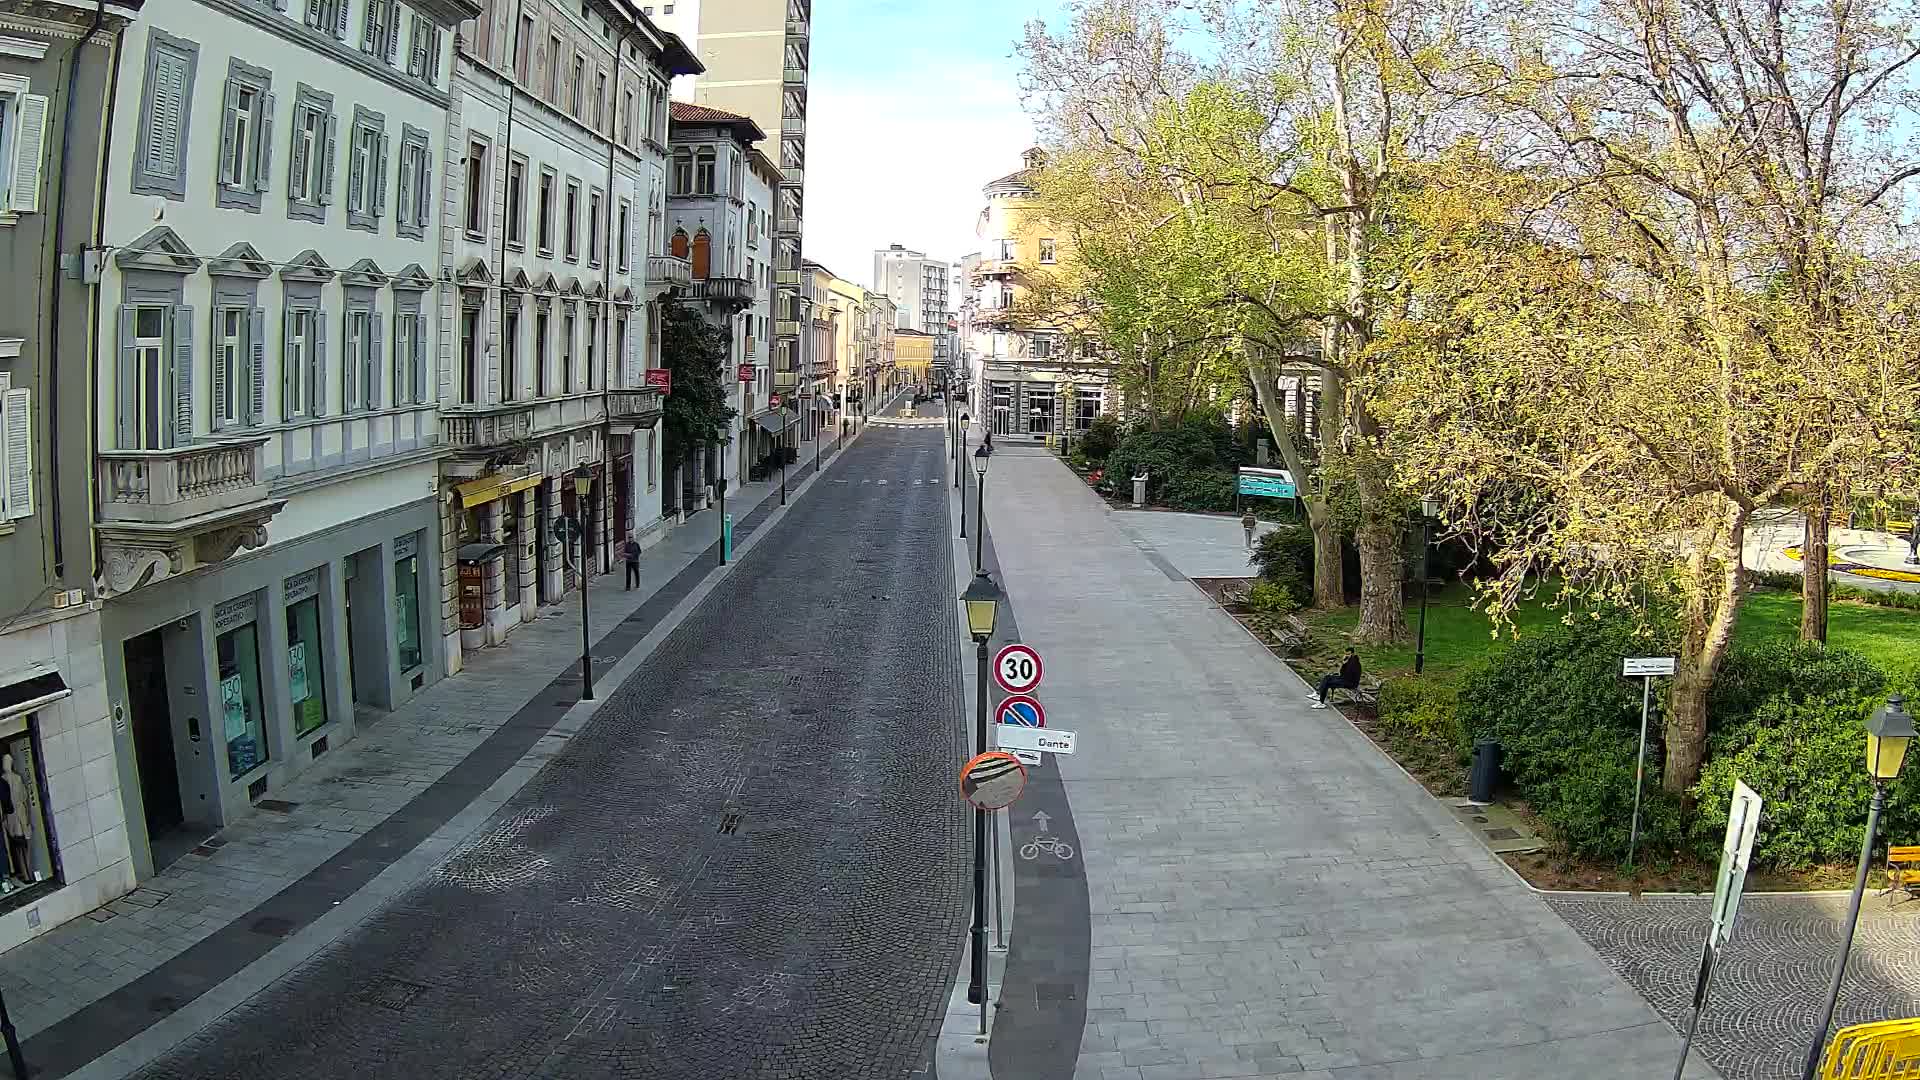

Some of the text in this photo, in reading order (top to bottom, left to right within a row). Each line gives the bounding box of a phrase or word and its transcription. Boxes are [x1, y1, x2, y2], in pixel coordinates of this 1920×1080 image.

[1005, 658, 1033, 680] 30
[221, 677, 240, 701] 130
[1038, 738, 1069, 749] Dante
